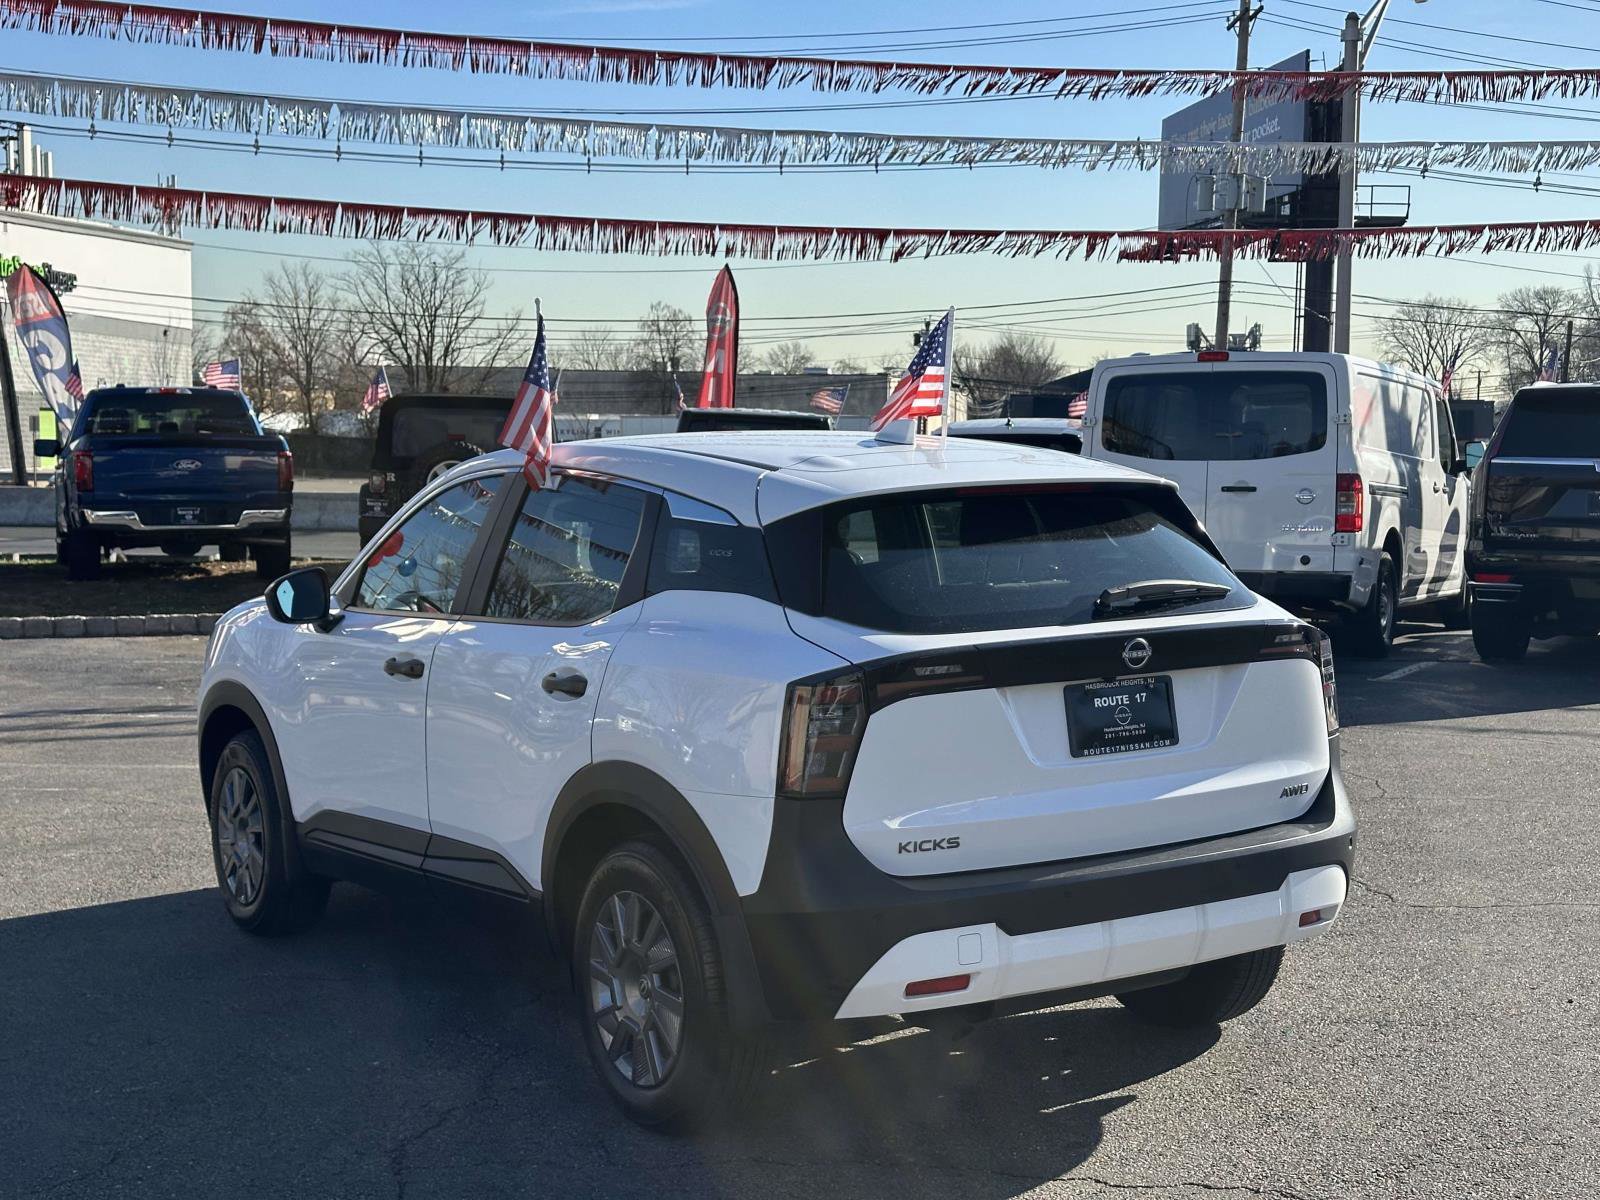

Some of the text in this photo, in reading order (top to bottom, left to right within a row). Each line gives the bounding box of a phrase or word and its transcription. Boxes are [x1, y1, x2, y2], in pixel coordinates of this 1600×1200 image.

[1094, 693, 1147, 708] ROUTE 17
[1083, 739, 1170, 756] ROUTE17NISSAN.COM
[1279, 783, 1309, 798] AWD
[898, 837, 961, 854] KICKS
